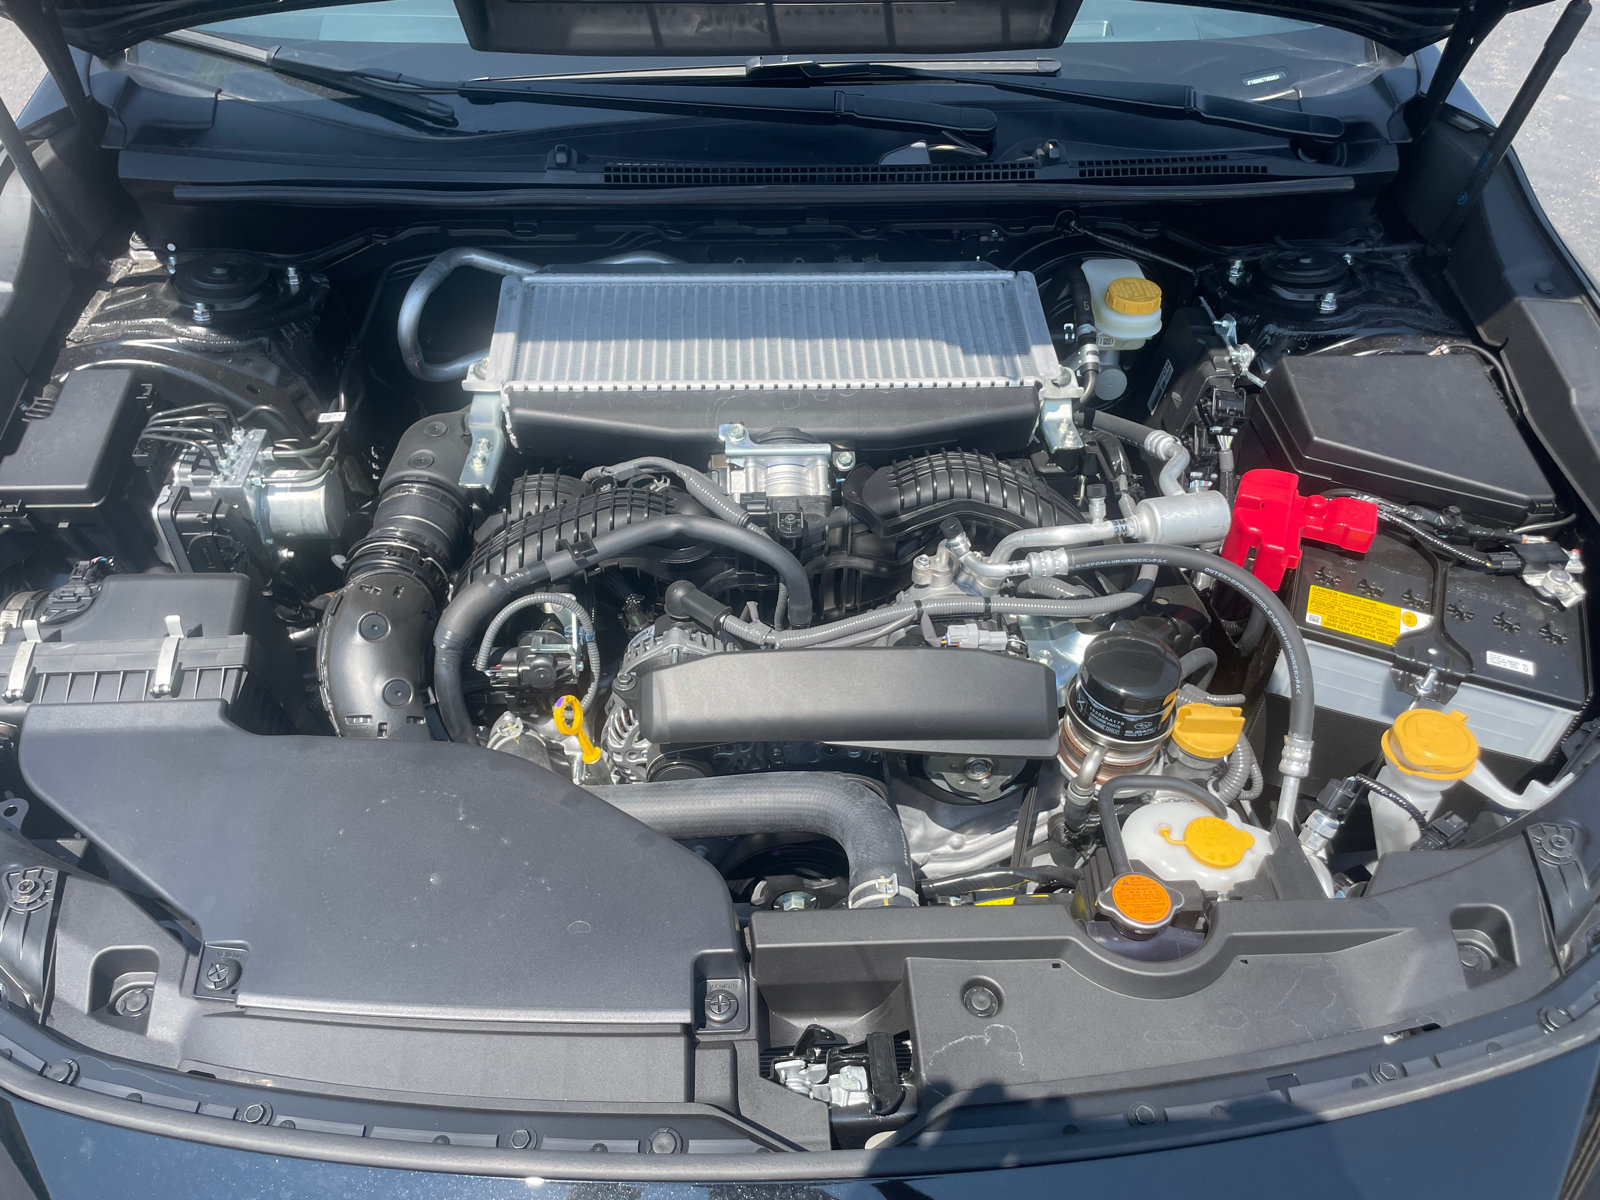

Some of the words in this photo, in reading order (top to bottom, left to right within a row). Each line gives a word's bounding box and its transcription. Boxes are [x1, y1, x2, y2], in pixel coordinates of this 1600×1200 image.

[1114, 526, 1128, 534] 3M
[1312, 586, 1338, 596] DANGER
[1311, 600, 1335, 610] POISON
